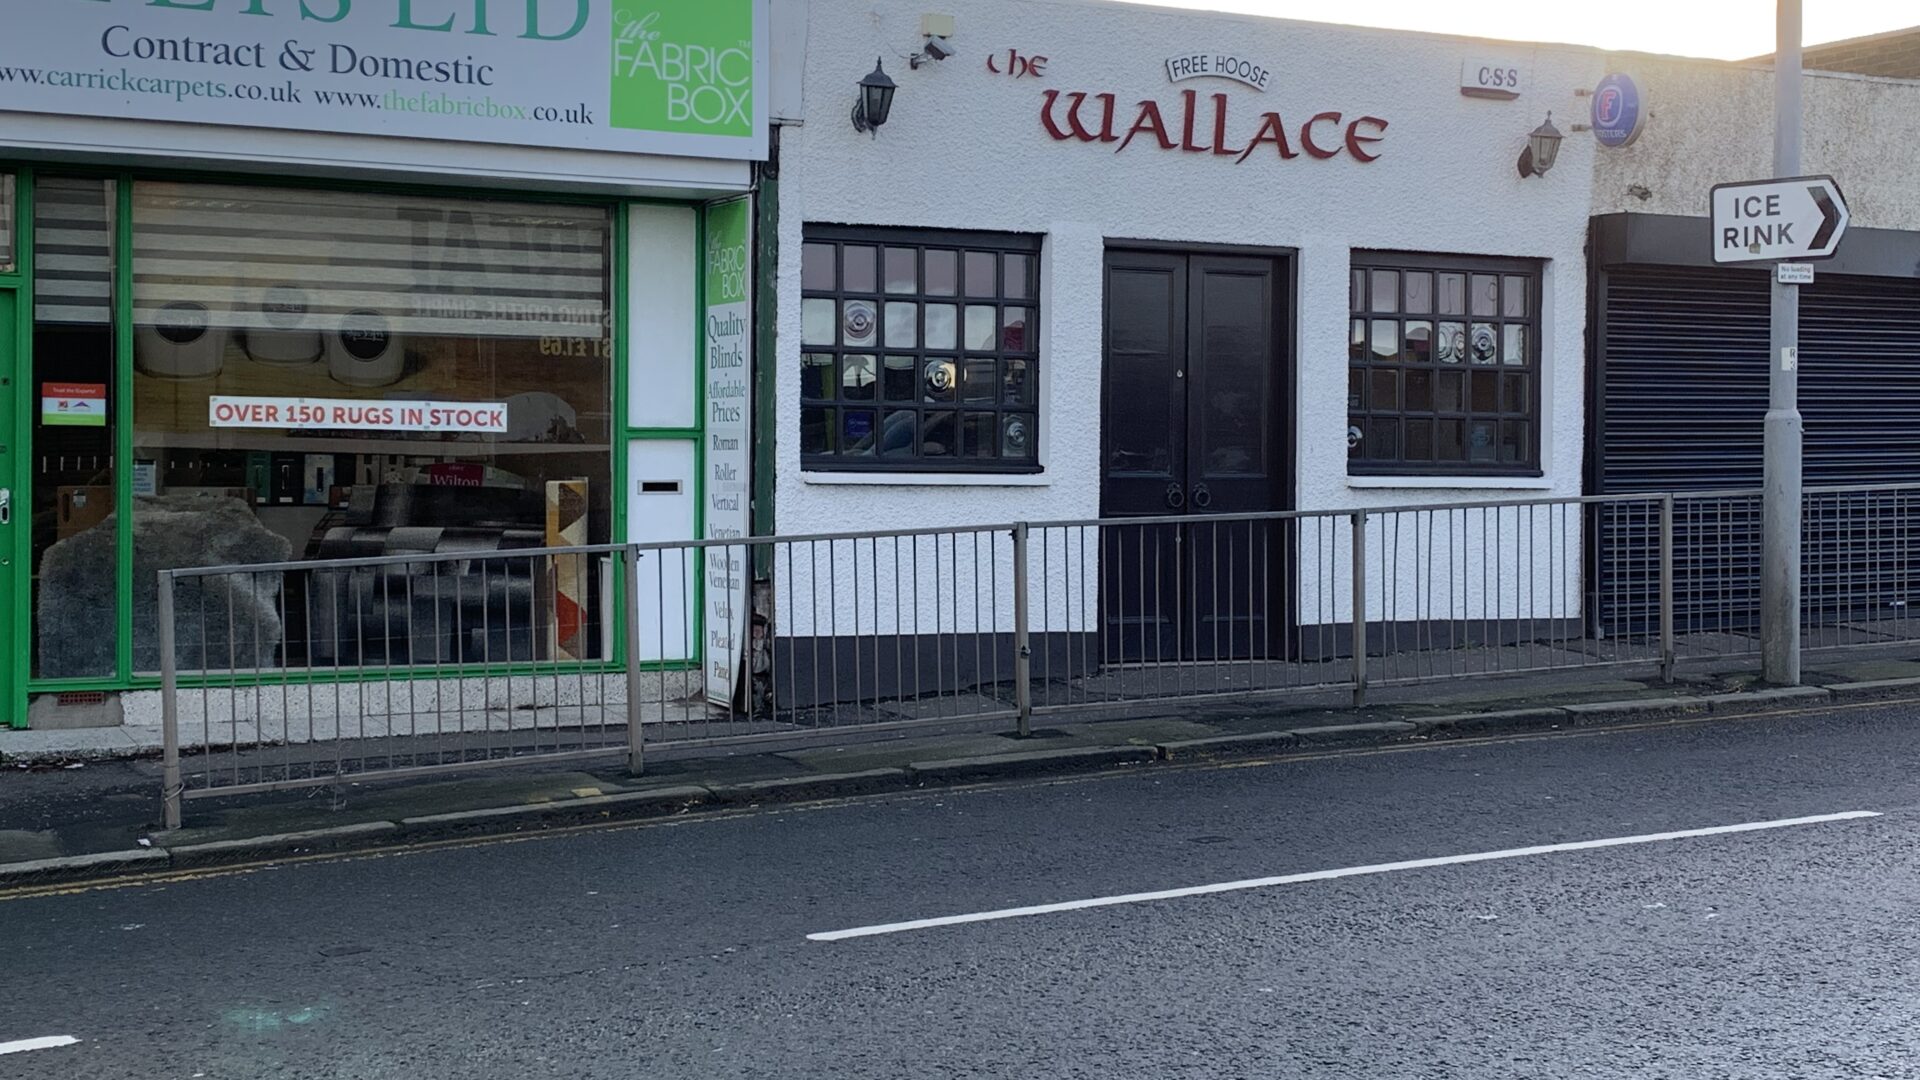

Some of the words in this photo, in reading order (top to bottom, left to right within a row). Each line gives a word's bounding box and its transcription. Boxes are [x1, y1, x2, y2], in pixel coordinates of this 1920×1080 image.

[101, 25, 266, 68] Contract
[279, 39, 315, 72] &
[328, 43, 494, 86] Domestic
[614, 38, 750, 87] FABRIC
[1172, 55, 1209, 78] FREE
[1215, 56, 1270, 88] HOOSE
[314, 89, 594, 125] www.thefabricbox.co.uk
[667, 83, 751, 127] BOX
[1734, 194, 1781, 219] ICE
[1723, 223, 1794, 248] RINK
[709, 245, 745, 275] FABRIC
[722, 272, 745, 298] BOX
[708, 312, 745, 342] Quality
[710, 346, 743, 370] Blinds
[708, 380, 745, 400] Affordable
[216, 404, 279, 423] OVER
[285, 406, 325, 424] 150
[332, 407, 394, 425] RUGS
[400, 409, 423, 425] IN
[429, 409, 503, 428] STOCK
[712, 401, 740, 422] Prices
[713, 435, 739, 451] Roman
[434, 474, 480, 486] Wilton
[714, 464, 736, 481] Roller
[712, 494, 739, 512] Vertical
